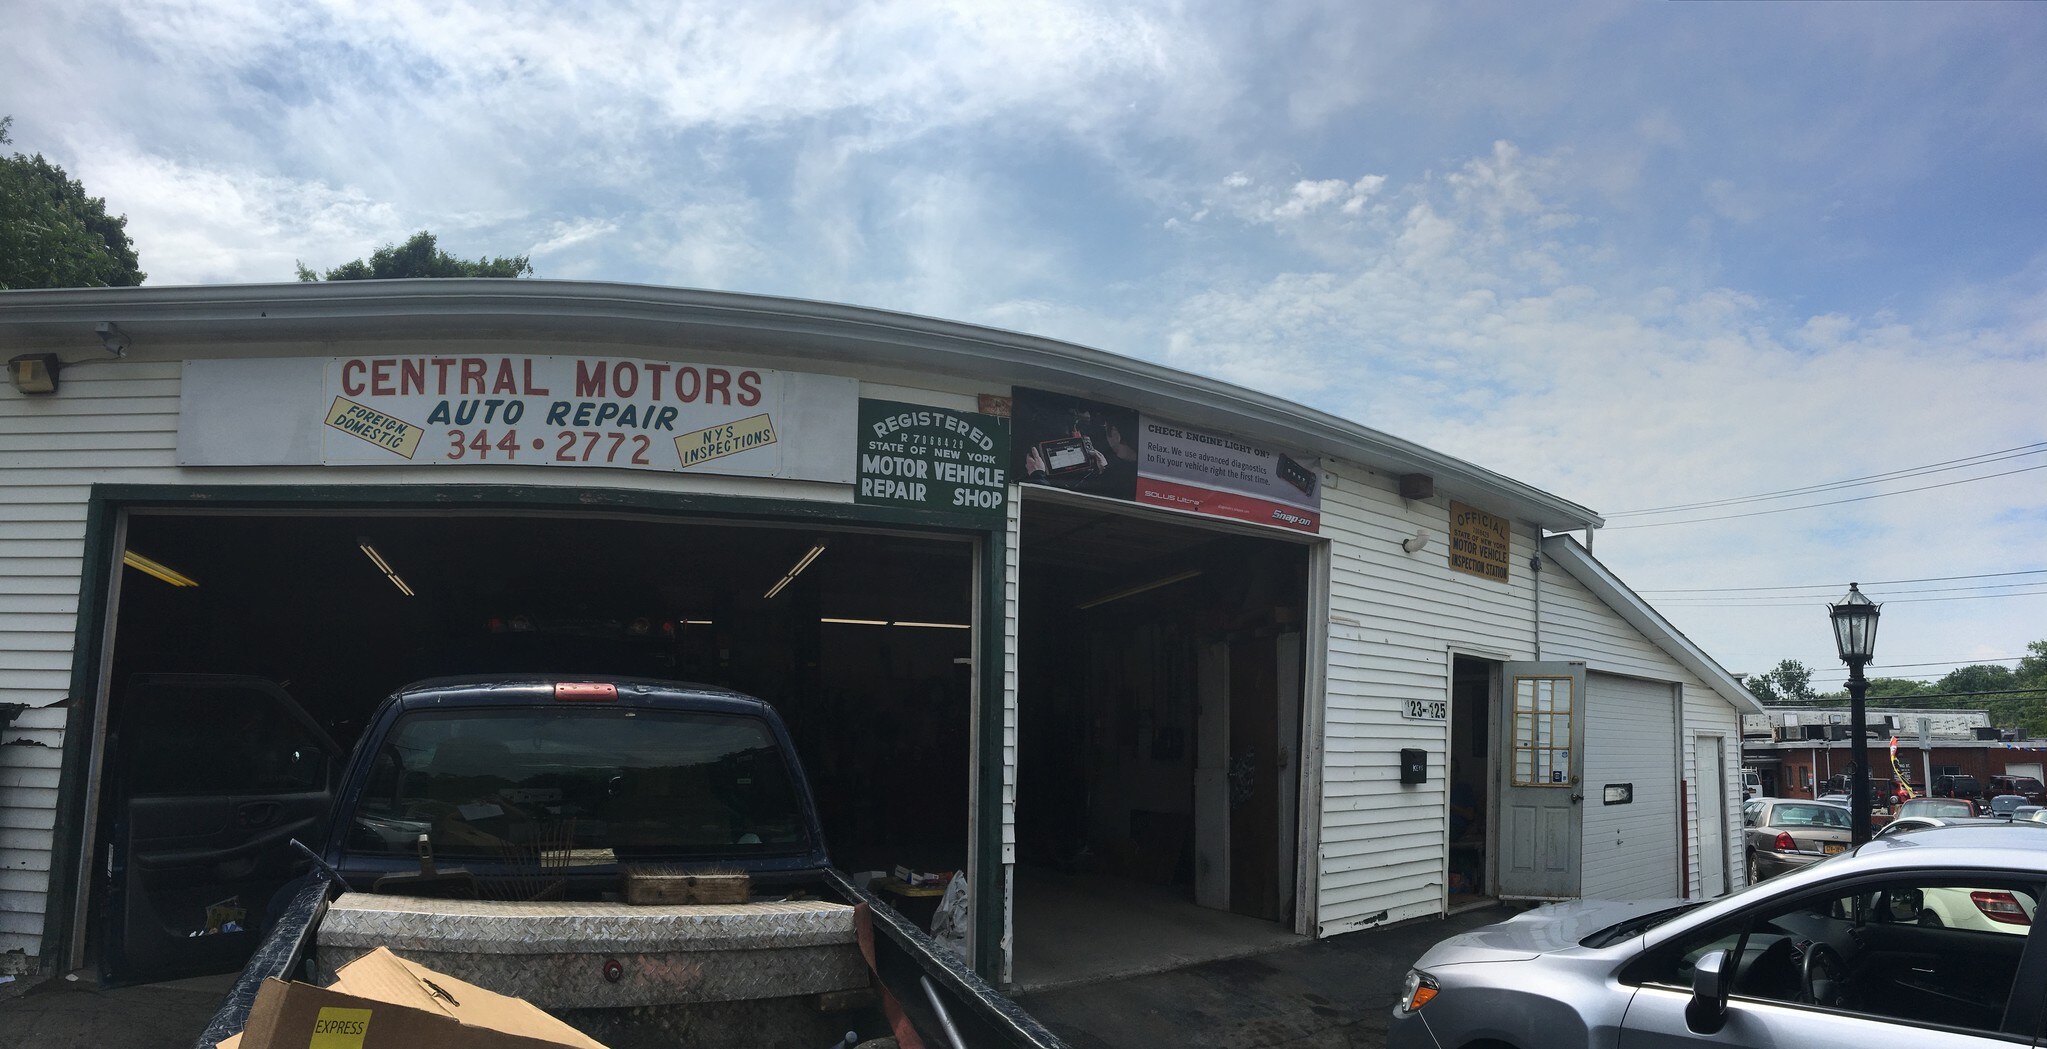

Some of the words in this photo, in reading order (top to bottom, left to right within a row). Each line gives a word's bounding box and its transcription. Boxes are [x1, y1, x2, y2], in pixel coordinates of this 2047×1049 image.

[342, 358, 550, 397] CENTRAL
[575, 360, 762, 407] MOTORS
[427, 400, 525, 426] AUTO
[546, 401, 678, 431] REPAIR
[334, 414, 404, 448] DOMESTIC
[684, 428, 771, 464] INSPECTIONS
[703, 425, 734, 445] NYS
[872, 411, 994, 451] REGISTERED
[901, 432, 908, 443] R
[1148, 424, 1183, 439] CHECK
[1186, 431, 1223, 447] ENGINE
[1225, 440, 1252, 455] LIGHT
[1254, 448, 1270, 459] ON?
[869, 441, 904, 452] STATE
[910, 445, 927, 455] OF
[934, 448, 961, 460] NEW
[967, 452, 996, 464] YORK
[1147, 441, 1170, 454] Relax.
[1171, 446, 1182, 457] We
[1184, 450, 1197, 459] use
[1198, 453, 1230, 466] advanced
[1231, 458, 1267, 475] diagnostics
[862, 453, 928, 480] MOTOR
[934, 461, 1005, 489] VEHICLE
[1147, 453, 1155, 462] to
[1156, 455, 1166, 465] fix
[1167, 458, 1183, 470] your
[1184, 461, 1209, 473] vehicle
[1210, 465, 1226, 479] right
[1227, 468, 1239, 479] the
[1240, 471, 1254, 483] first
[1254, 474, 1271, 486] time.
[861, 477, 927, 502] REPAIR
[953, 487, 1003, 510] SHOP
[1145, 490, 1176, 501] SOLUS
[1272, 510, 1312, 527] Snap-on
[1457, 511, 1505, 540] OFFICIAL
[1453, 537, 1477, 556] MOTOR
[1480, 545, 1507, 564] VEHICLE
[1454, 529, 1470, 540] STATE
[1471, 534, 1479, 542] OF
[1480, 538, 1492, 547] NEW
[1493, 542, 1506, 551] YORK
[1452, 554, 1484, 573] INSPECTION
[1486, 563, 1507, 579] STATION
[315, 1019, 364, 1035] EXPRESS
